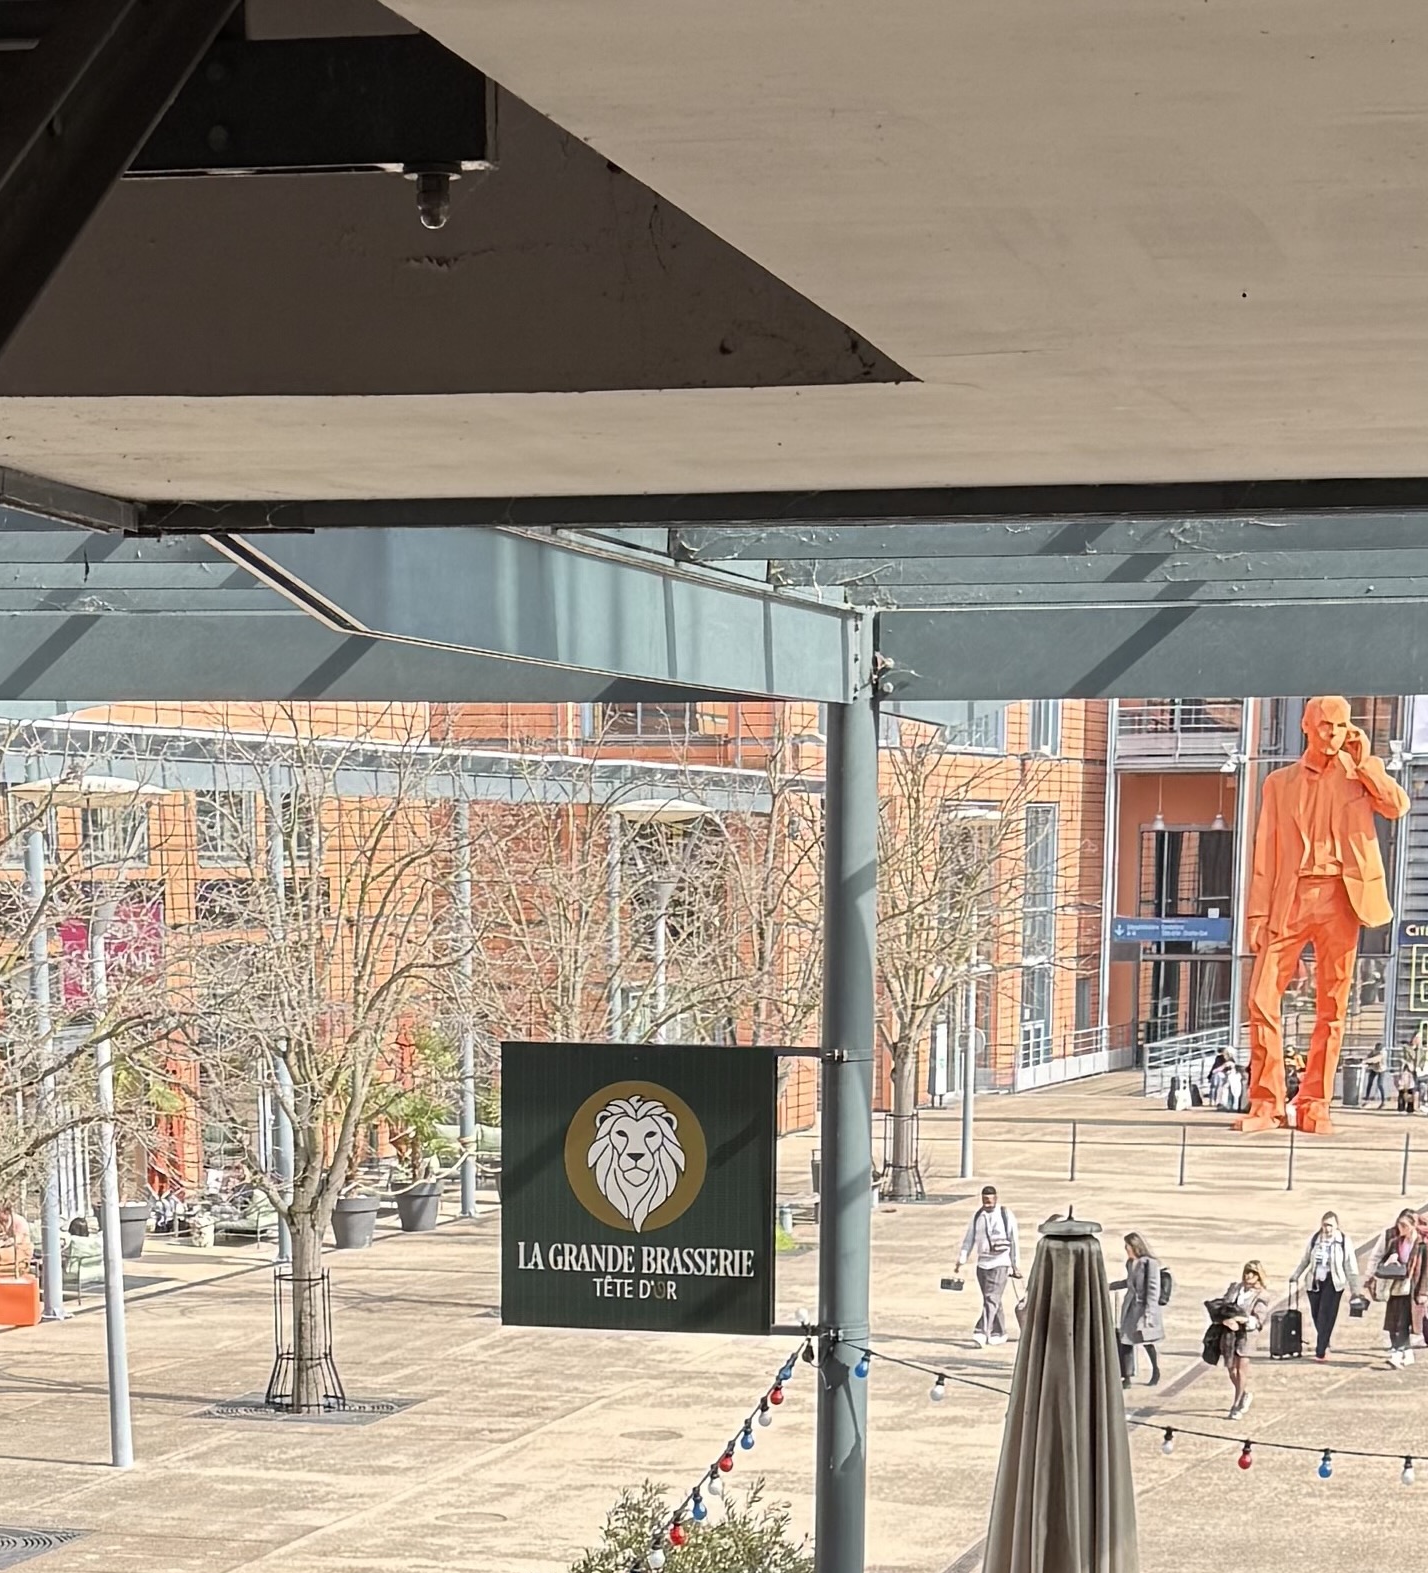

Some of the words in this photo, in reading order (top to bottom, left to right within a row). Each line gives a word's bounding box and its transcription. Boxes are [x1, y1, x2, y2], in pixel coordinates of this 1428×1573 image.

[517, 1241, 544, 1270] LA
[548, 1243, 636, 1274] GRANDE
[641, 1246, 755, 1278] BRASSERIE
[592, 1275, 634, 1299] TÊTE
[639, 1279, 677, 1300] D'OR
